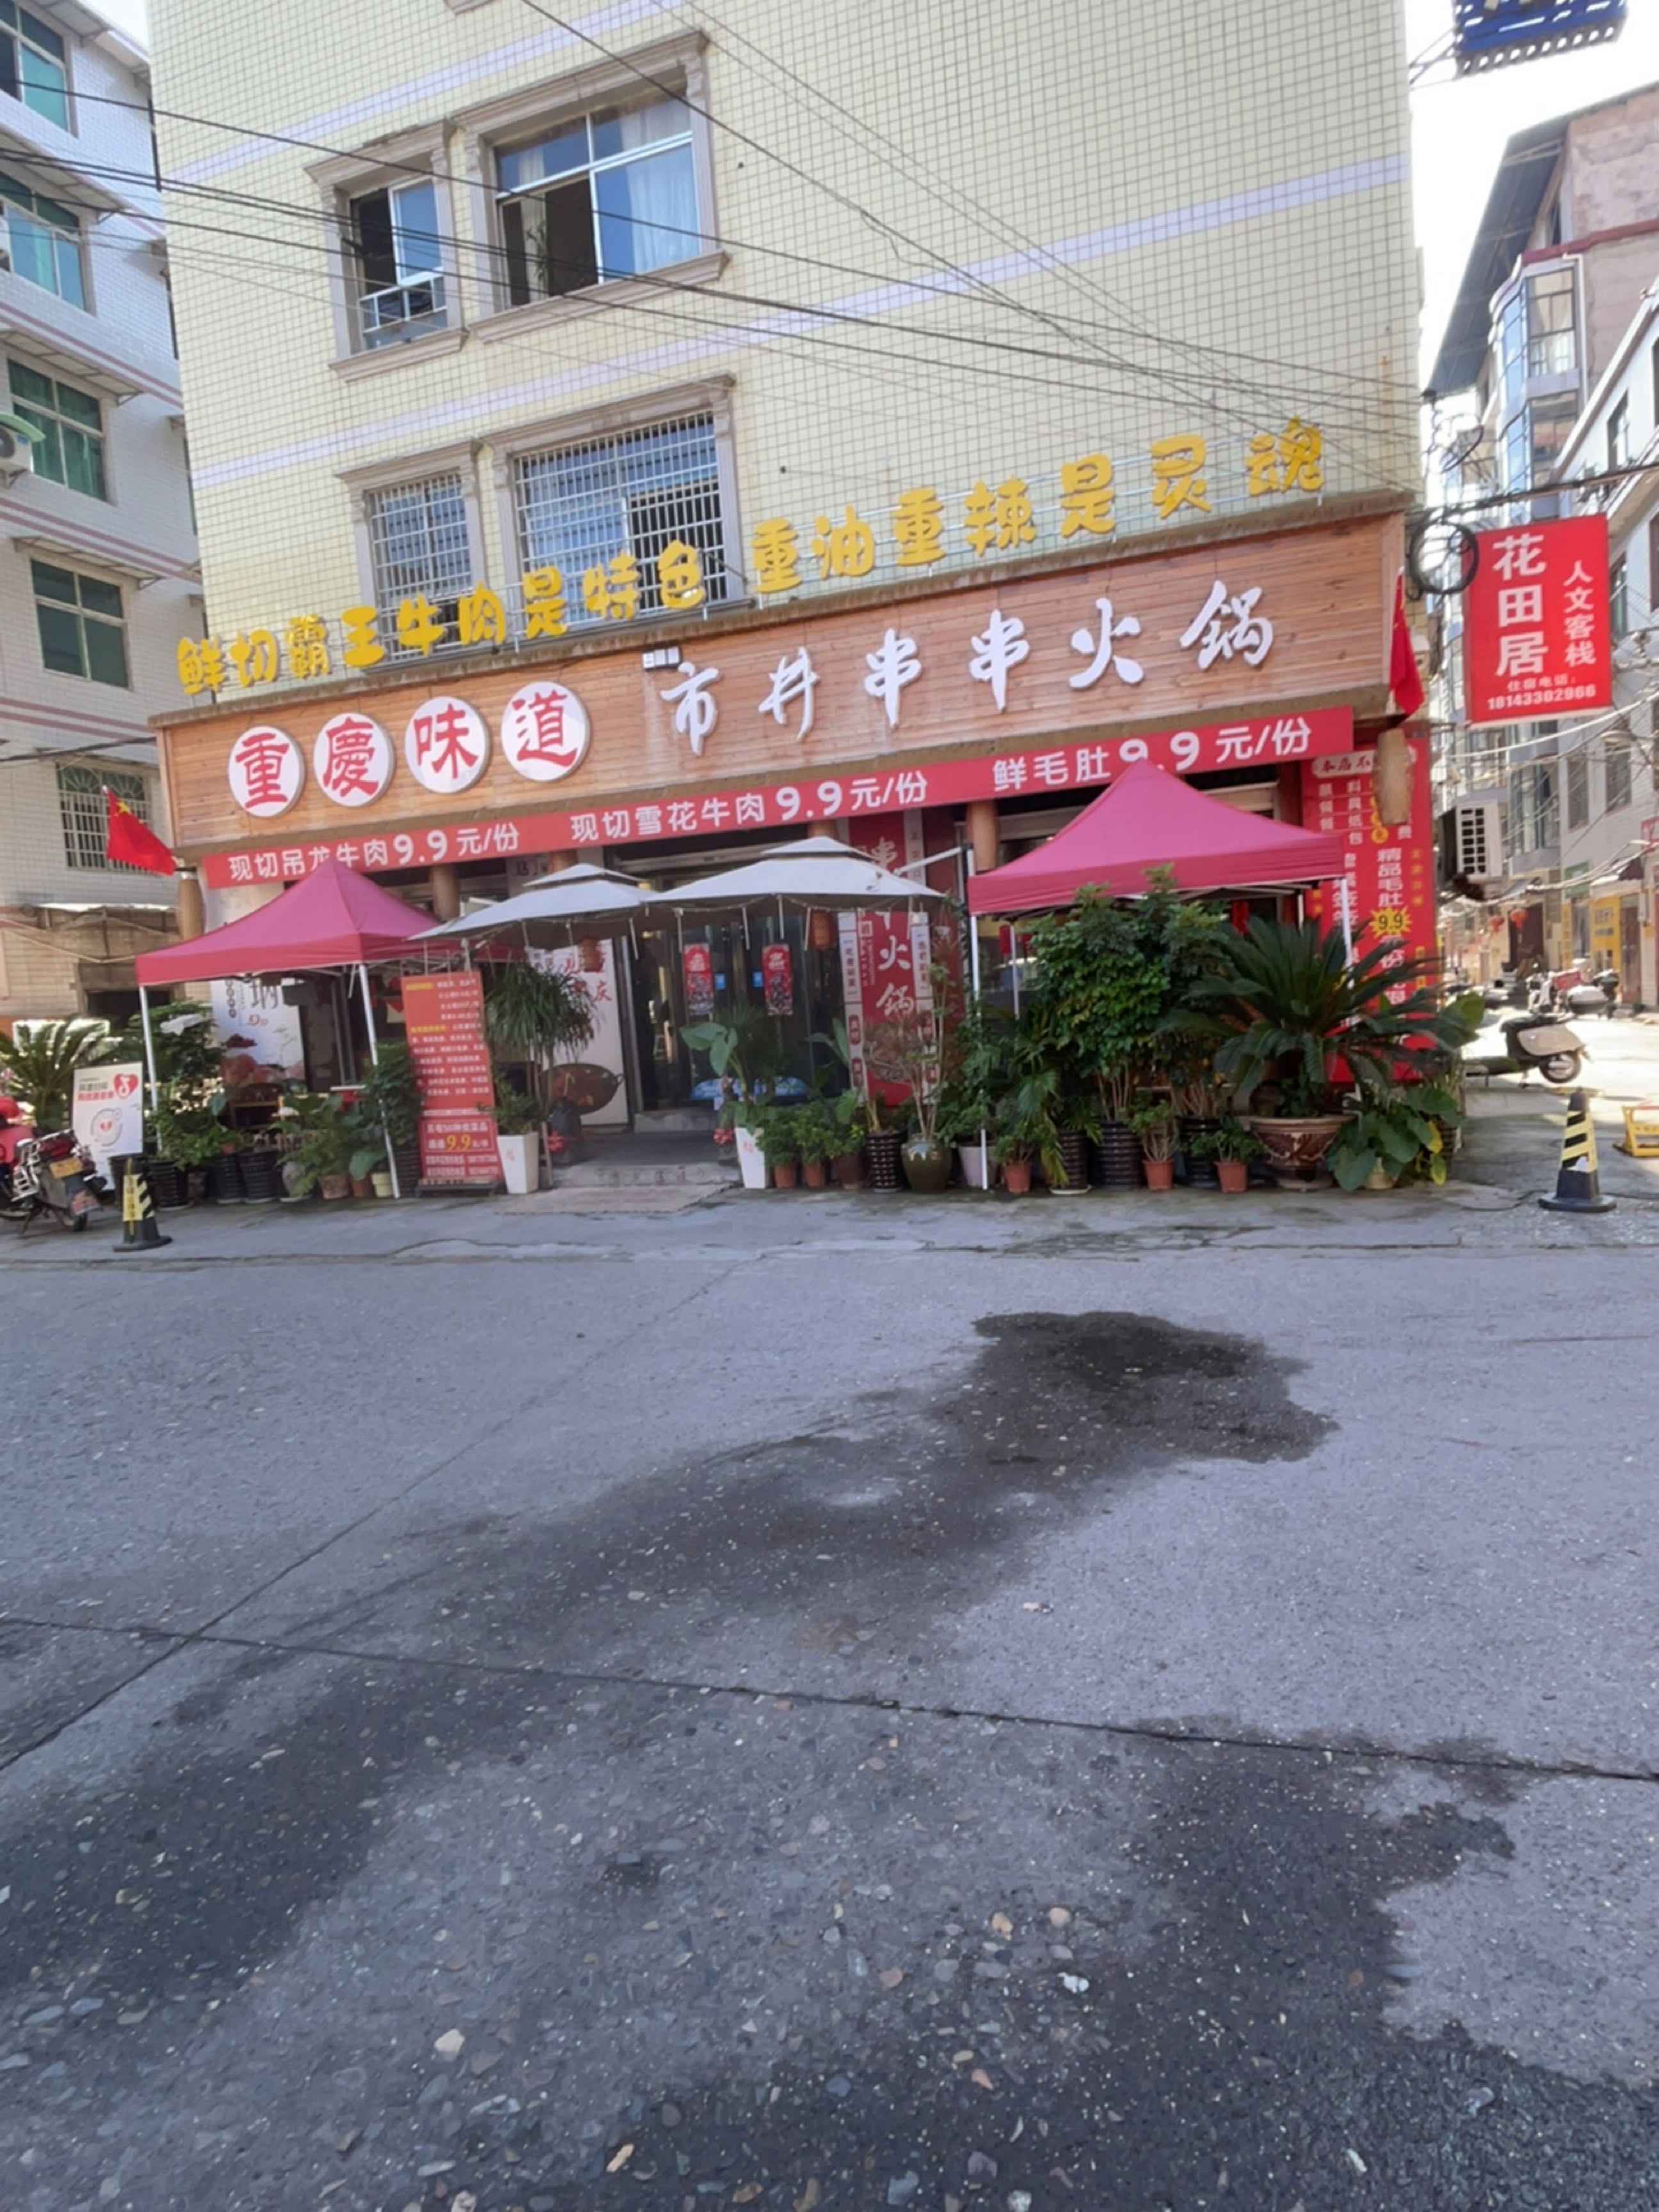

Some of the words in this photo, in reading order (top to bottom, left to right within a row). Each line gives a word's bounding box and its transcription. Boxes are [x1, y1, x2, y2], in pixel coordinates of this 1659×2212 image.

[751, 413, 1325, 594] 重油重辣是灵魂
[176, 540, 706, 696] 鲜切霸王牛肉是特色
[661, 580, 1274, 755] 市井串串火锅
[1493, 533, 1549, 677] 花田居
[1563, 560, 1597, 668] 人文客栈
[1377, 913, 1404, 930] 9.9
[1378, 847, 1402, 908] 精品毛肚
